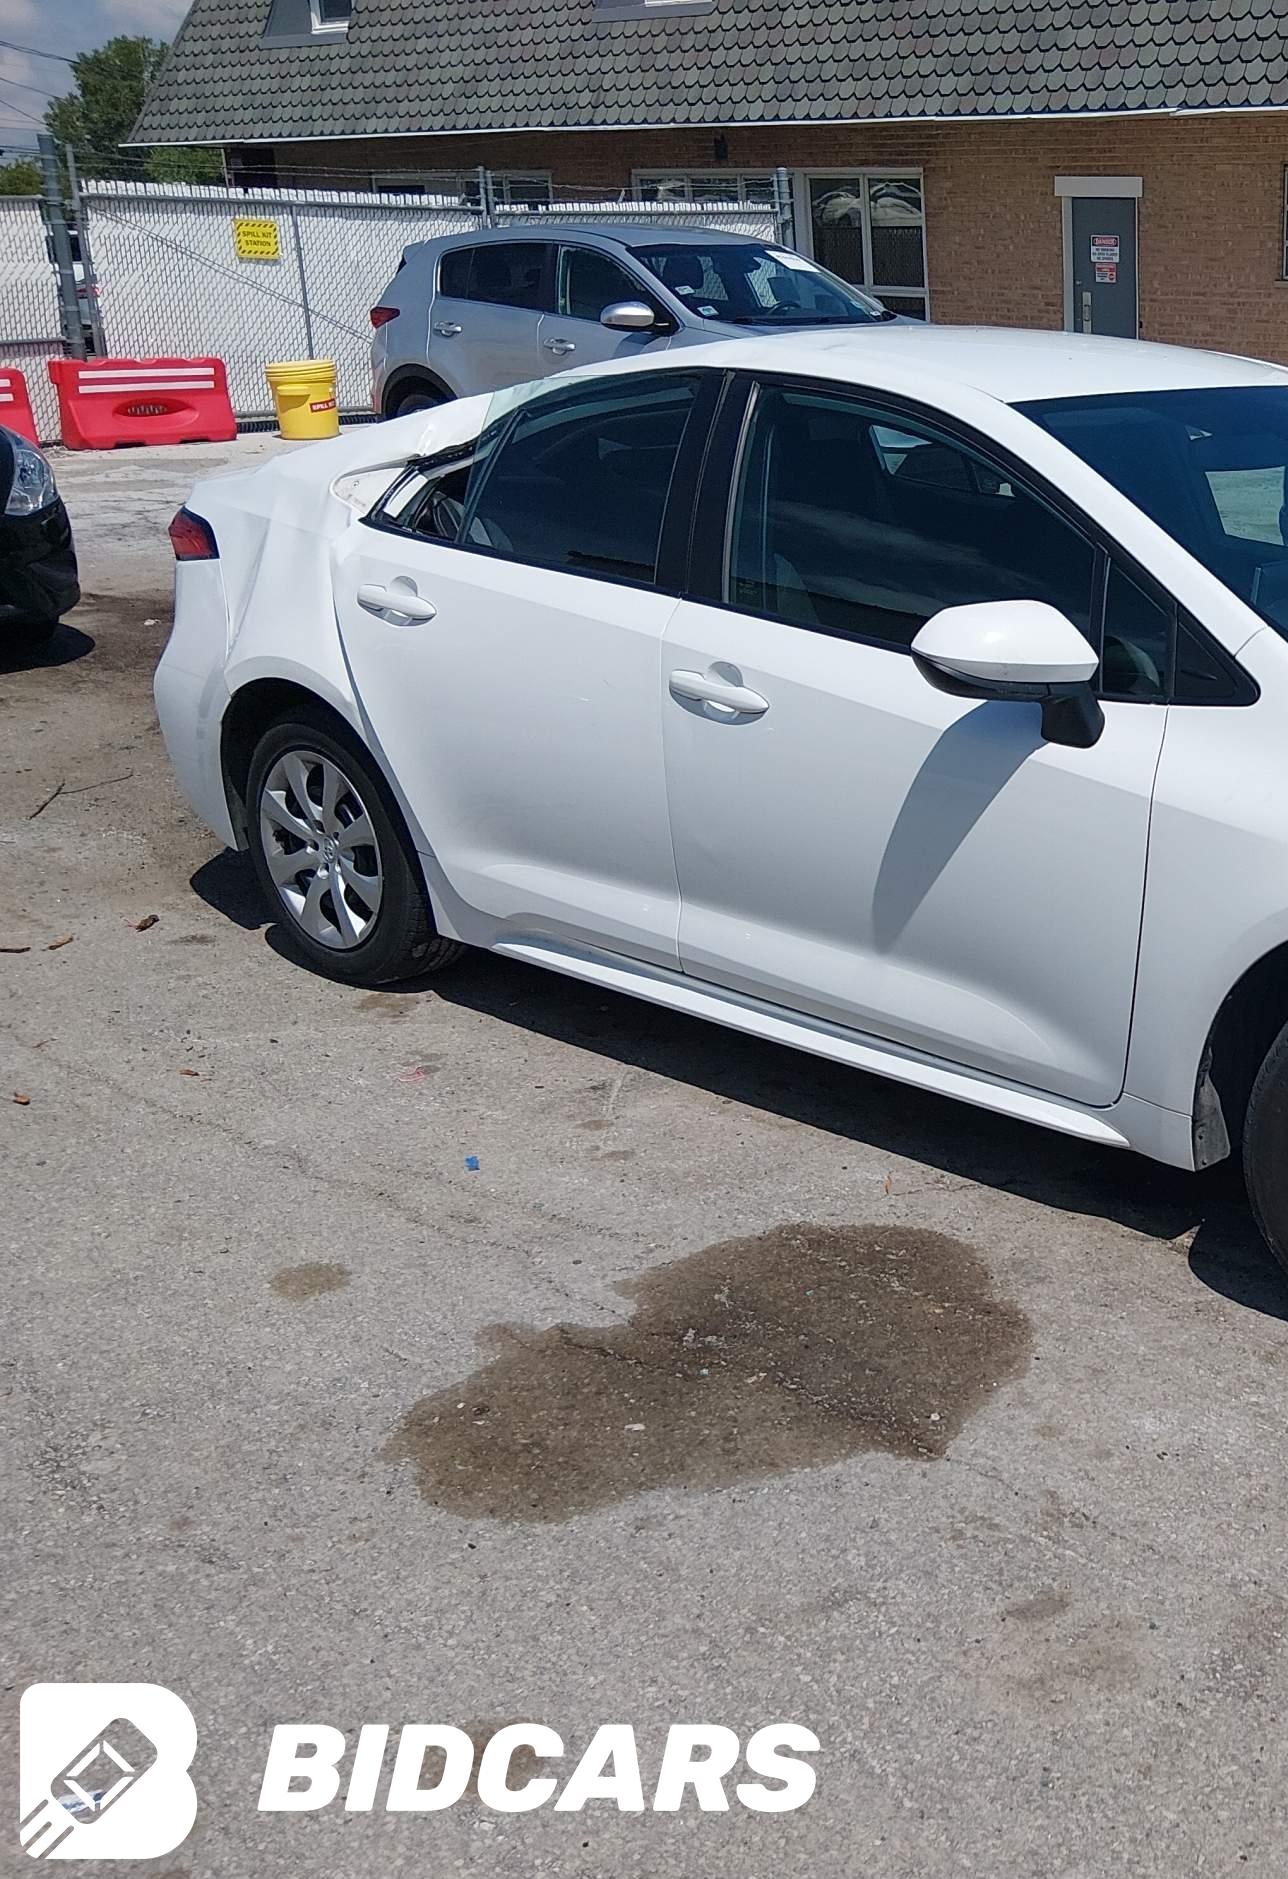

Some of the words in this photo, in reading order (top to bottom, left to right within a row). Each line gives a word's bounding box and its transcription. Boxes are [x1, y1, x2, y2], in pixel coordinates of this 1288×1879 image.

[242, 230, 260, 238] SPILL
[262, 231, 272, 239] KIT
[245, 239, 271, 247] STATION
